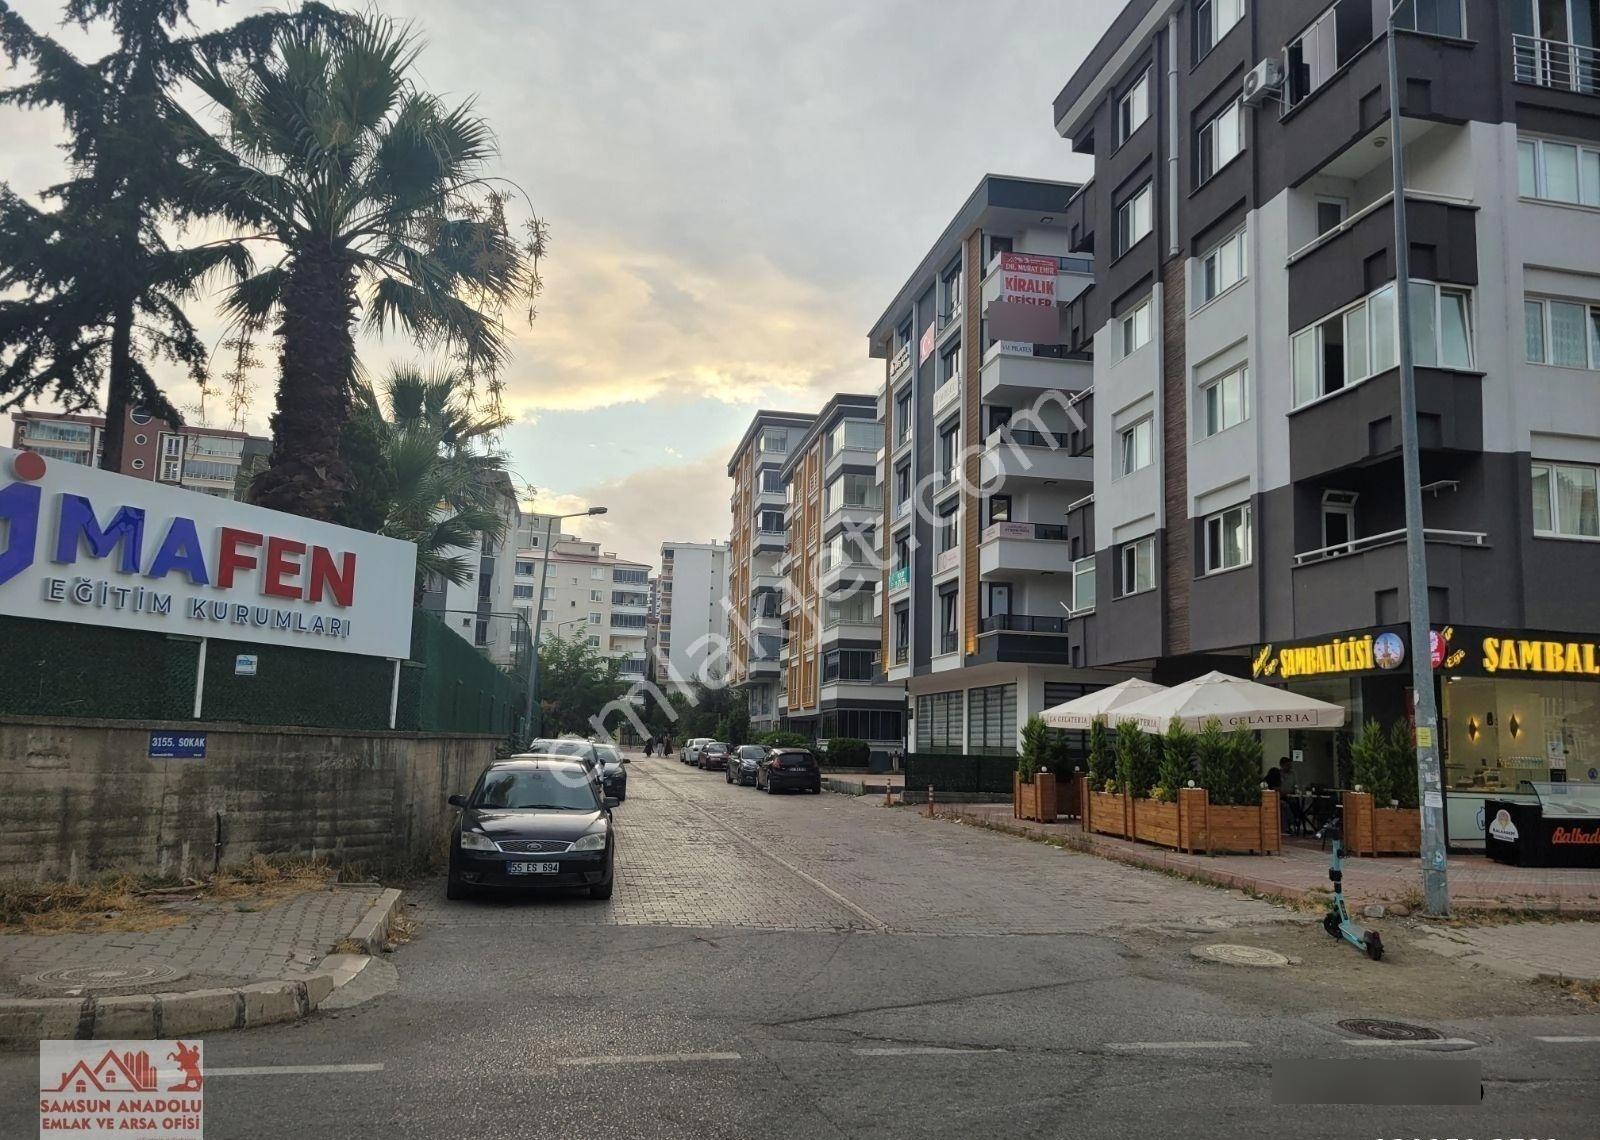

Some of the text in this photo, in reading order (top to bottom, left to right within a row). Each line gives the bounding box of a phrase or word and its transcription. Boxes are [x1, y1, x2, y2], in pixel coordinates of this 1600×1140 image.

[1005, 275, 1054, 295] KİRALIK
[50, 577, 351, 637] EĞİTİM KURUMLARI
[1280, 634, 1375, 678] ŞAMBALİCİSİ
[1446, 637, 1600, 675] Ege ŞAMBAL
[1057, 715, 1088, 724] GELATERIA
[1126, 716, 1157, 728] ATERIA
[152, 737, 205, 747] 3155. SOKAK
[512, 863, 558, 872] 55 ES 694
